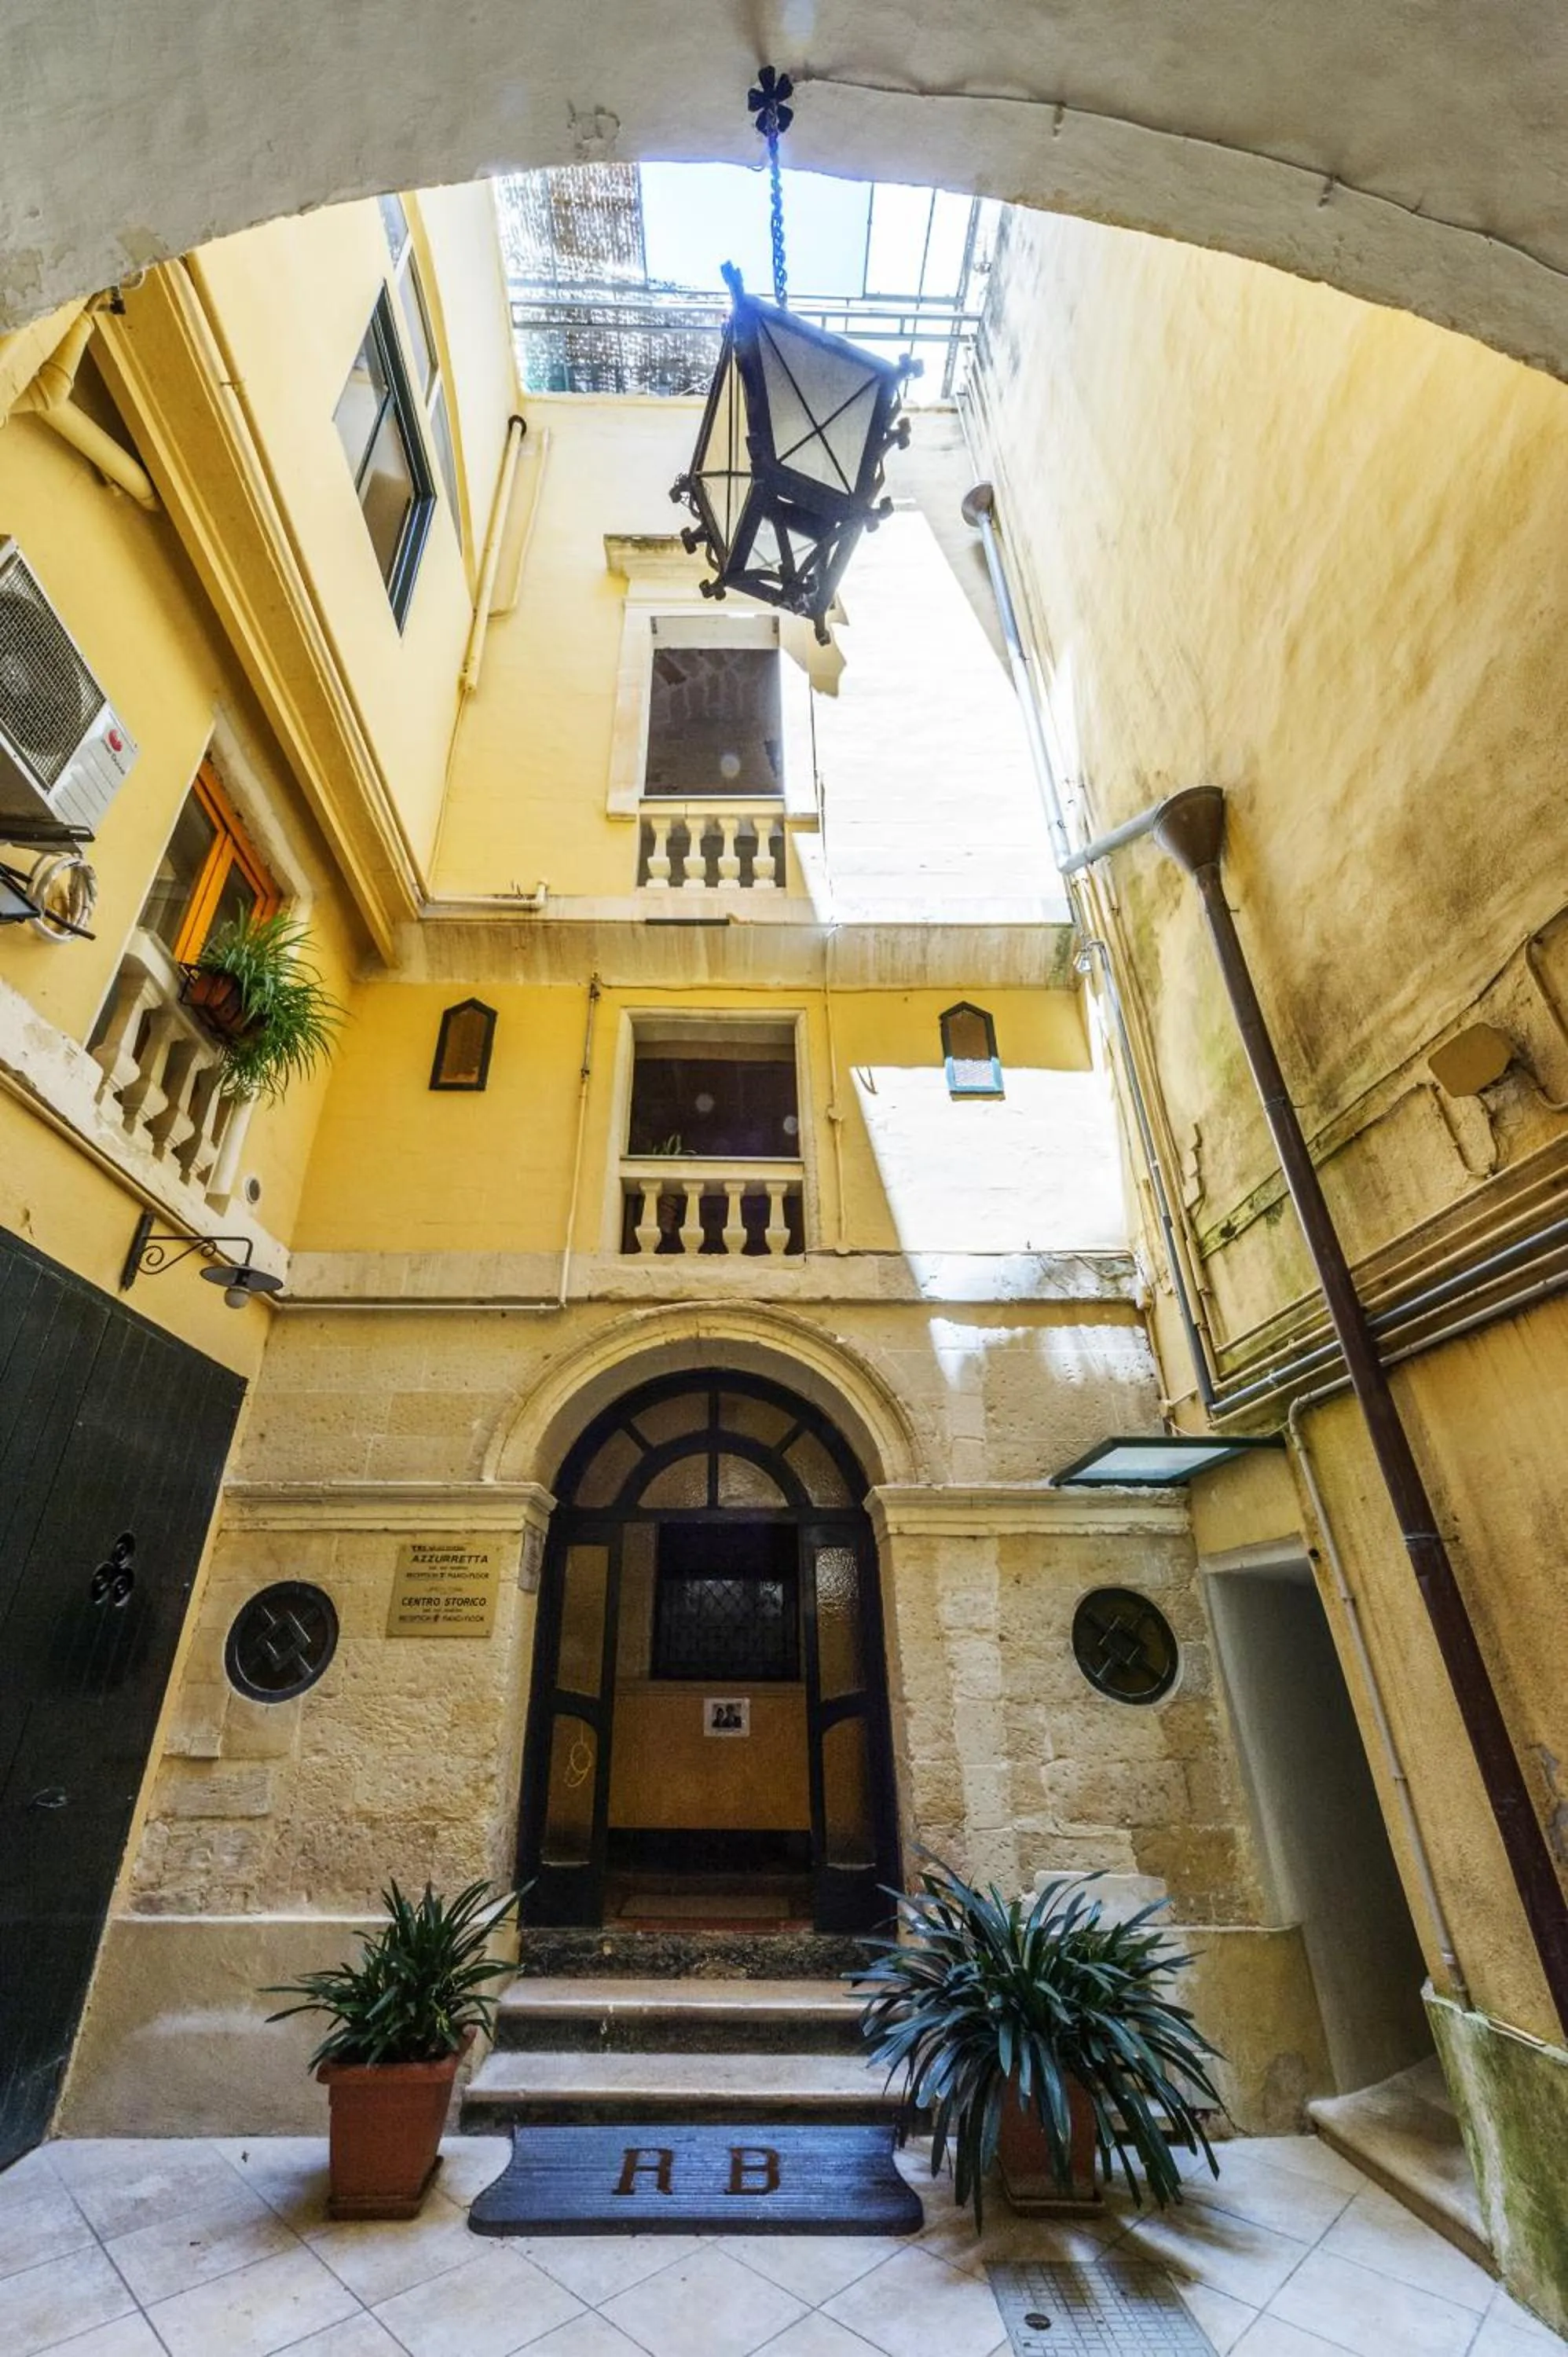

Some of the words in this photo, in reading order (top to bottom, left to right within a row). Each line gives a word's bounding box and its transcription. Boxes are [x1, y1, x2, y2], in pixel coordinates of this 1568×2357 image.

[412, 1555, 488, 1563] AZZURRETTA
[401, 1597, 441, 1607] CENTRO
[445, 1597, 487, 1607] STORICO
[724, 2147, 780, 2195] B
